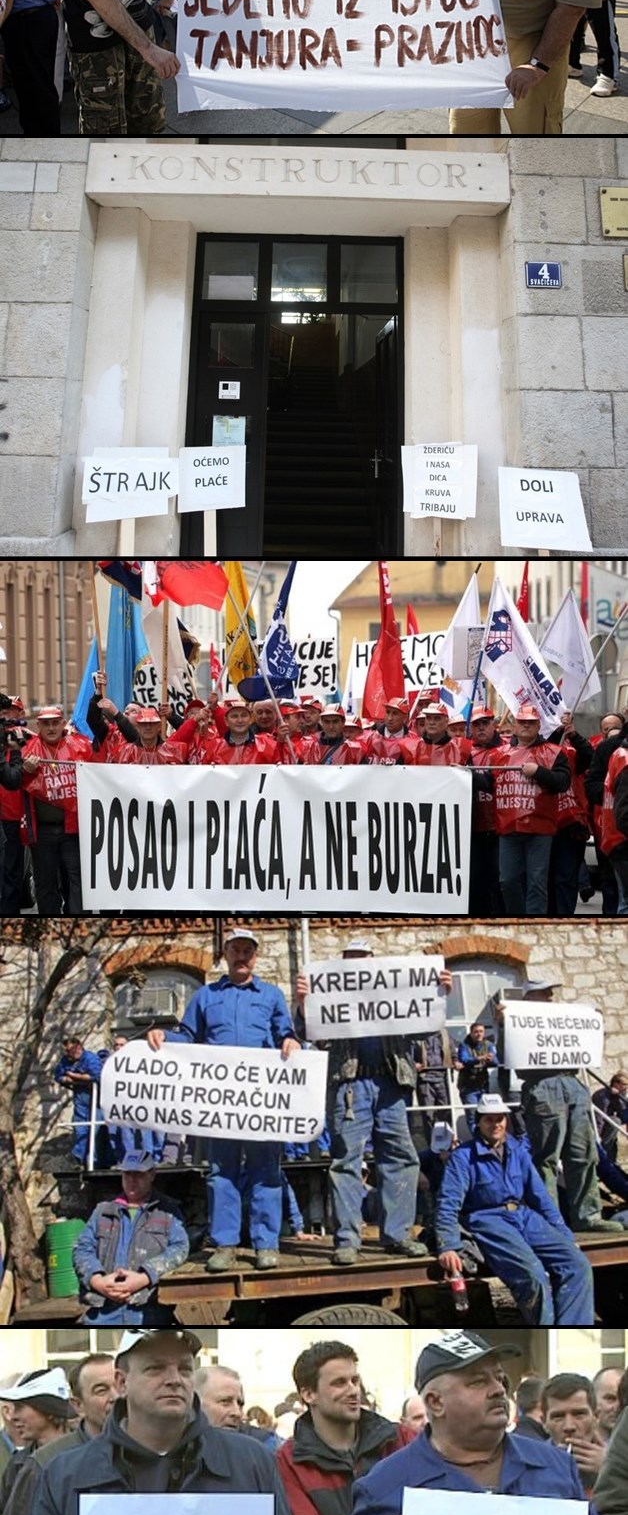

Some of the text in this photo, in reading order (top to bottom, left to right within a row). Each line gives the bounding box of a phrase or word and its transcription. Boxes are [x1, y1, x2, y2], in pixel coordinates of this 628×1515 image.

[127, 154, 469, 189] KONSTRUKTOR
[538, 264, 550, 279] 4
[193, 457, 230, 468] OĆEMO
[195, 474, 228, 488] PLAĆE
[429, 474, 447, 482] DICA
[425, 489, 451, 497] KRUVA
[520, 479, 554, 493] DOLI
[420, 503, 456, 513] TRIBAJU
[516, 511, 564, 524] UPRAVA
[45, 773, 76, 788] RADN
[47, 787, 78, 801] MJES
[496, 784, 536, 796] RADNIH
[496, 797, 535, 810] MJESTA
[90, 772, 463, 901] POSAO I PLAĆA, A NE BURZA!
[310, 967, 440, 994] KREPAT MA
[320, 997, 435, 1024] NE MOLAT
[536, 1030, 580, 1048] ŠKVER
[528, 1051, 592, 1066] NE DAMO
[113, 1056, 308, 1087] VLADO, TKO ĆE VAM
[114, 1081, 291, 1110] PUNITI PRORAČUN
[109, 1103, 319, 1136] AKO NAS ZATVORITE?
